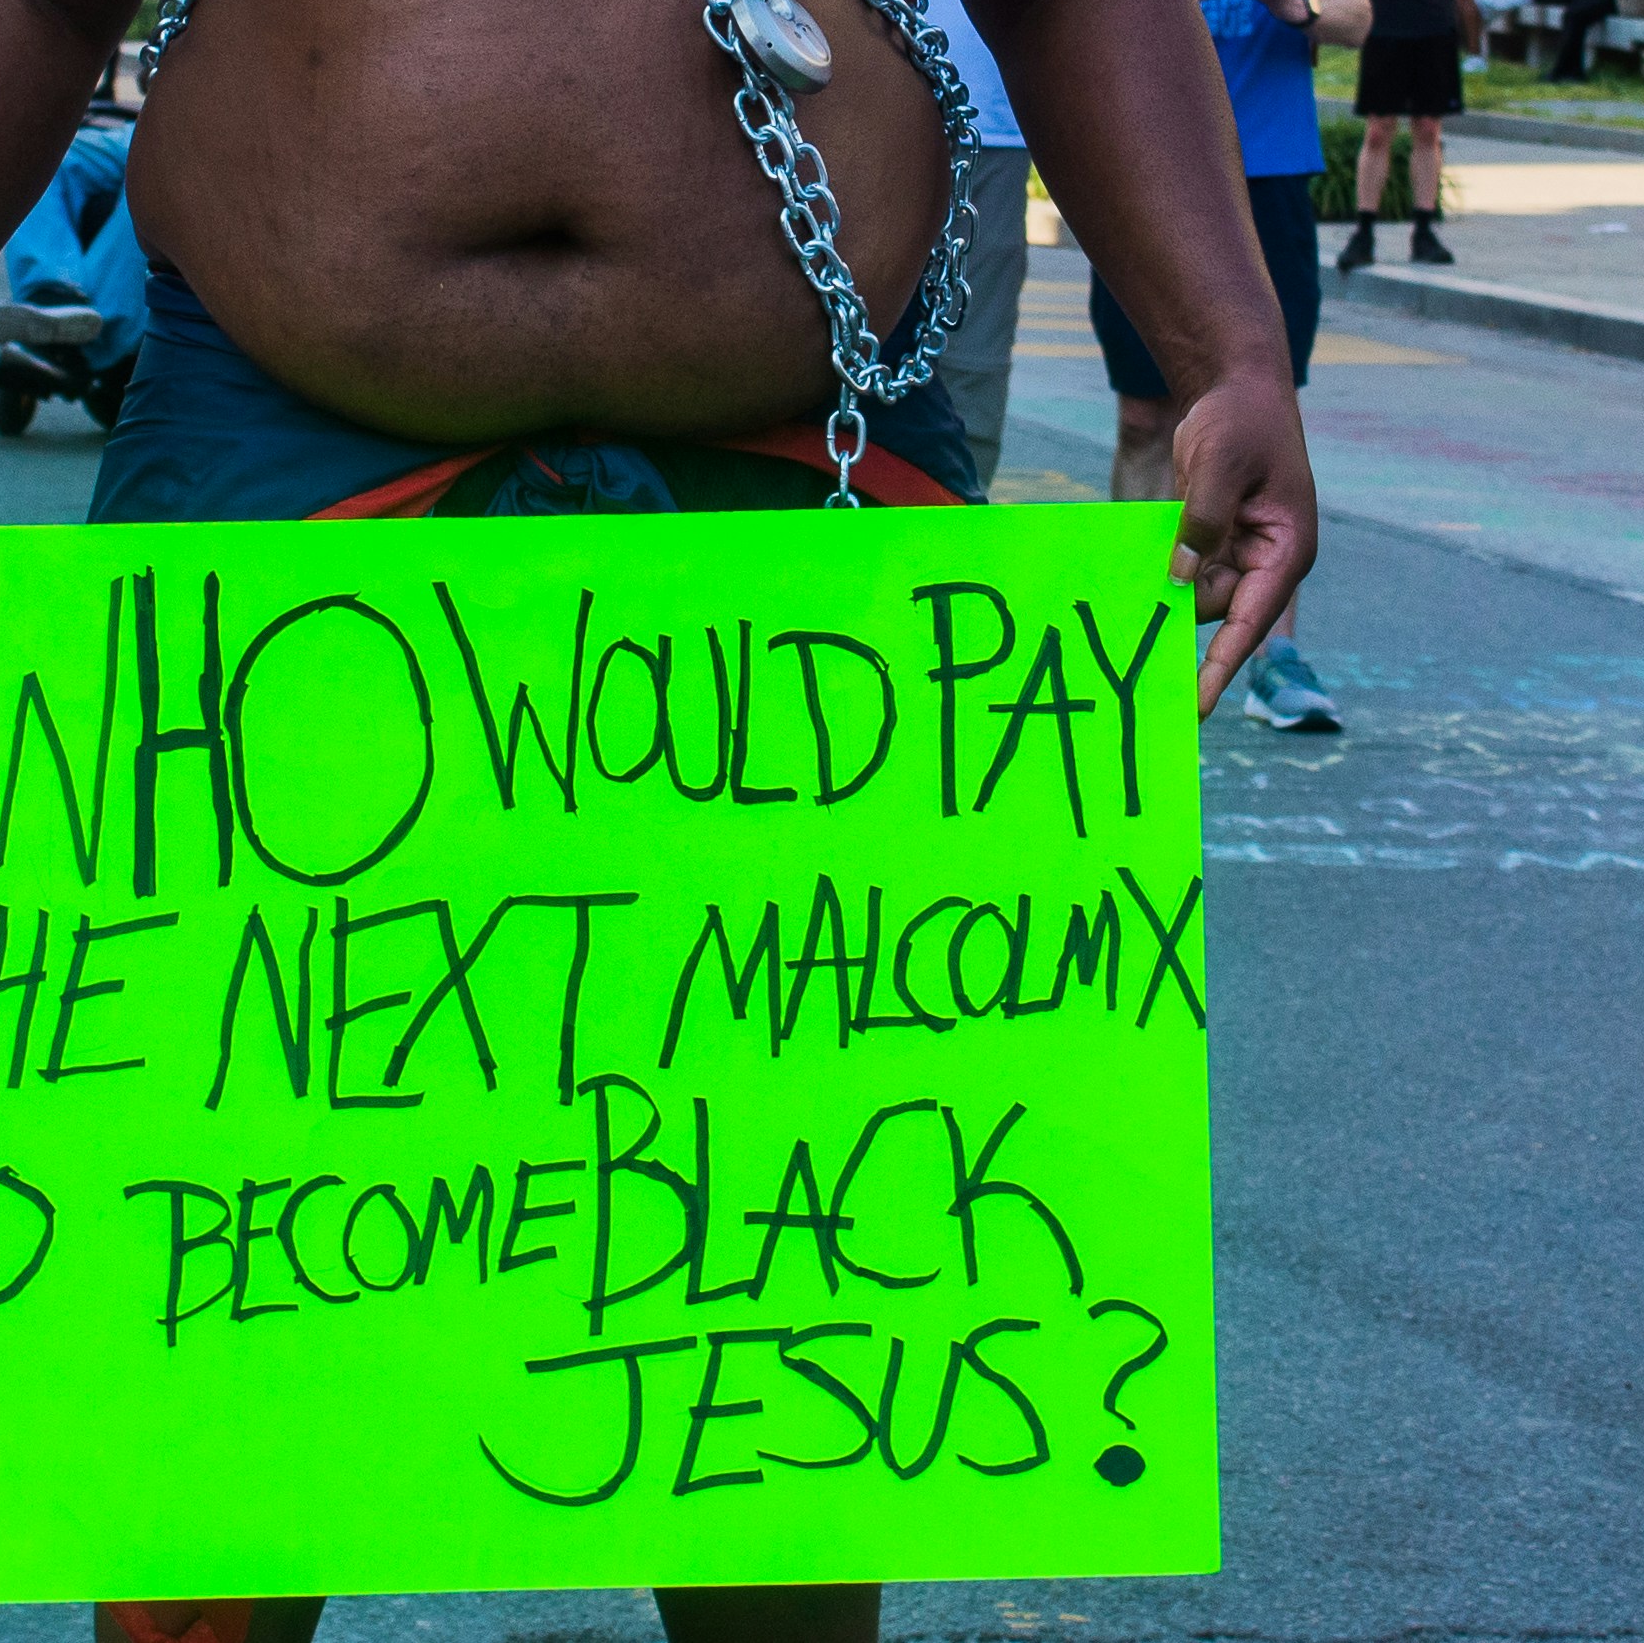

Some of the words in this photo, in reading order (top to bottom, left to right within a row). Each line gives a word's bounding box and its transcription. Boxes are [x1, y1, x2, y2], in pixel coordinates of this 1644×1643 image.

[432, 582, 897, 816] WOULD
[910, 582, 1170, 838] PAY
[205, 893, 639, 1111] NEXT
[123, 1160, 586, 1348] BECOME
[576, 1074, 1083, 1336] BLACK
[479, 1300, 1168, 1506] JESUS?
